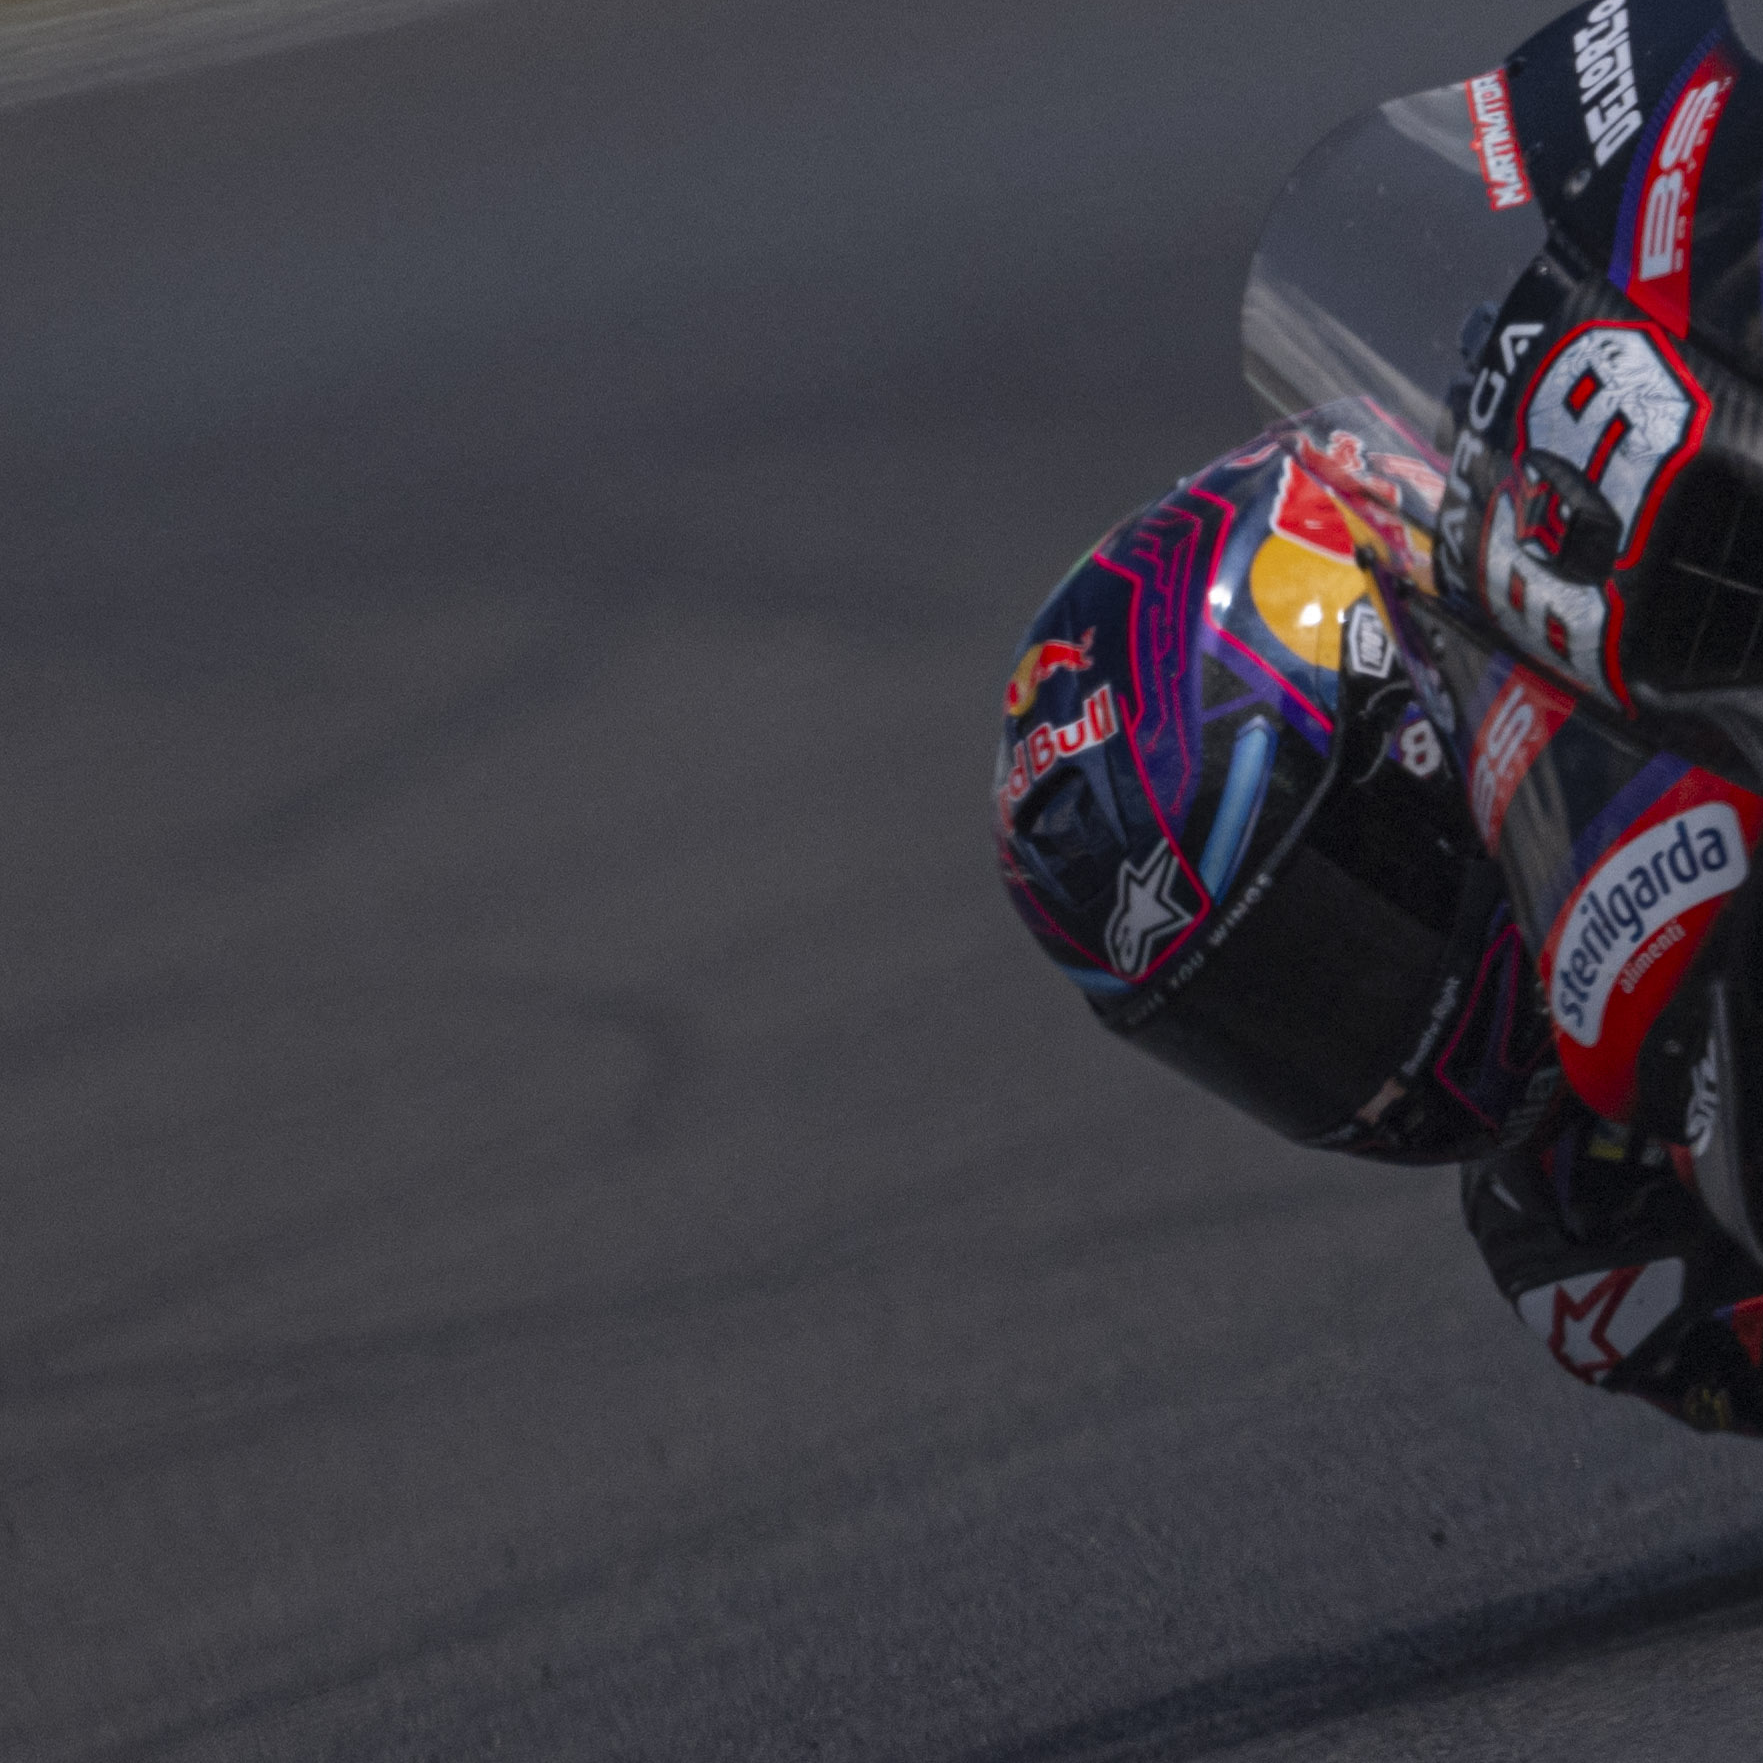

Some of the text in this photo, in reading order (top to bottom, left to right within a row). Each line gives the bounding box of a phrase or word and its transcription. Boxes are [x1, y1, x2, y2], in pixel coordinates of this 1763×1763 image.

[1471, 75, 1525, 208] MARTINATOR
[1638, 80, 1720, 282] BS
[1561, 819, 1728, 1029] sterilgarda
